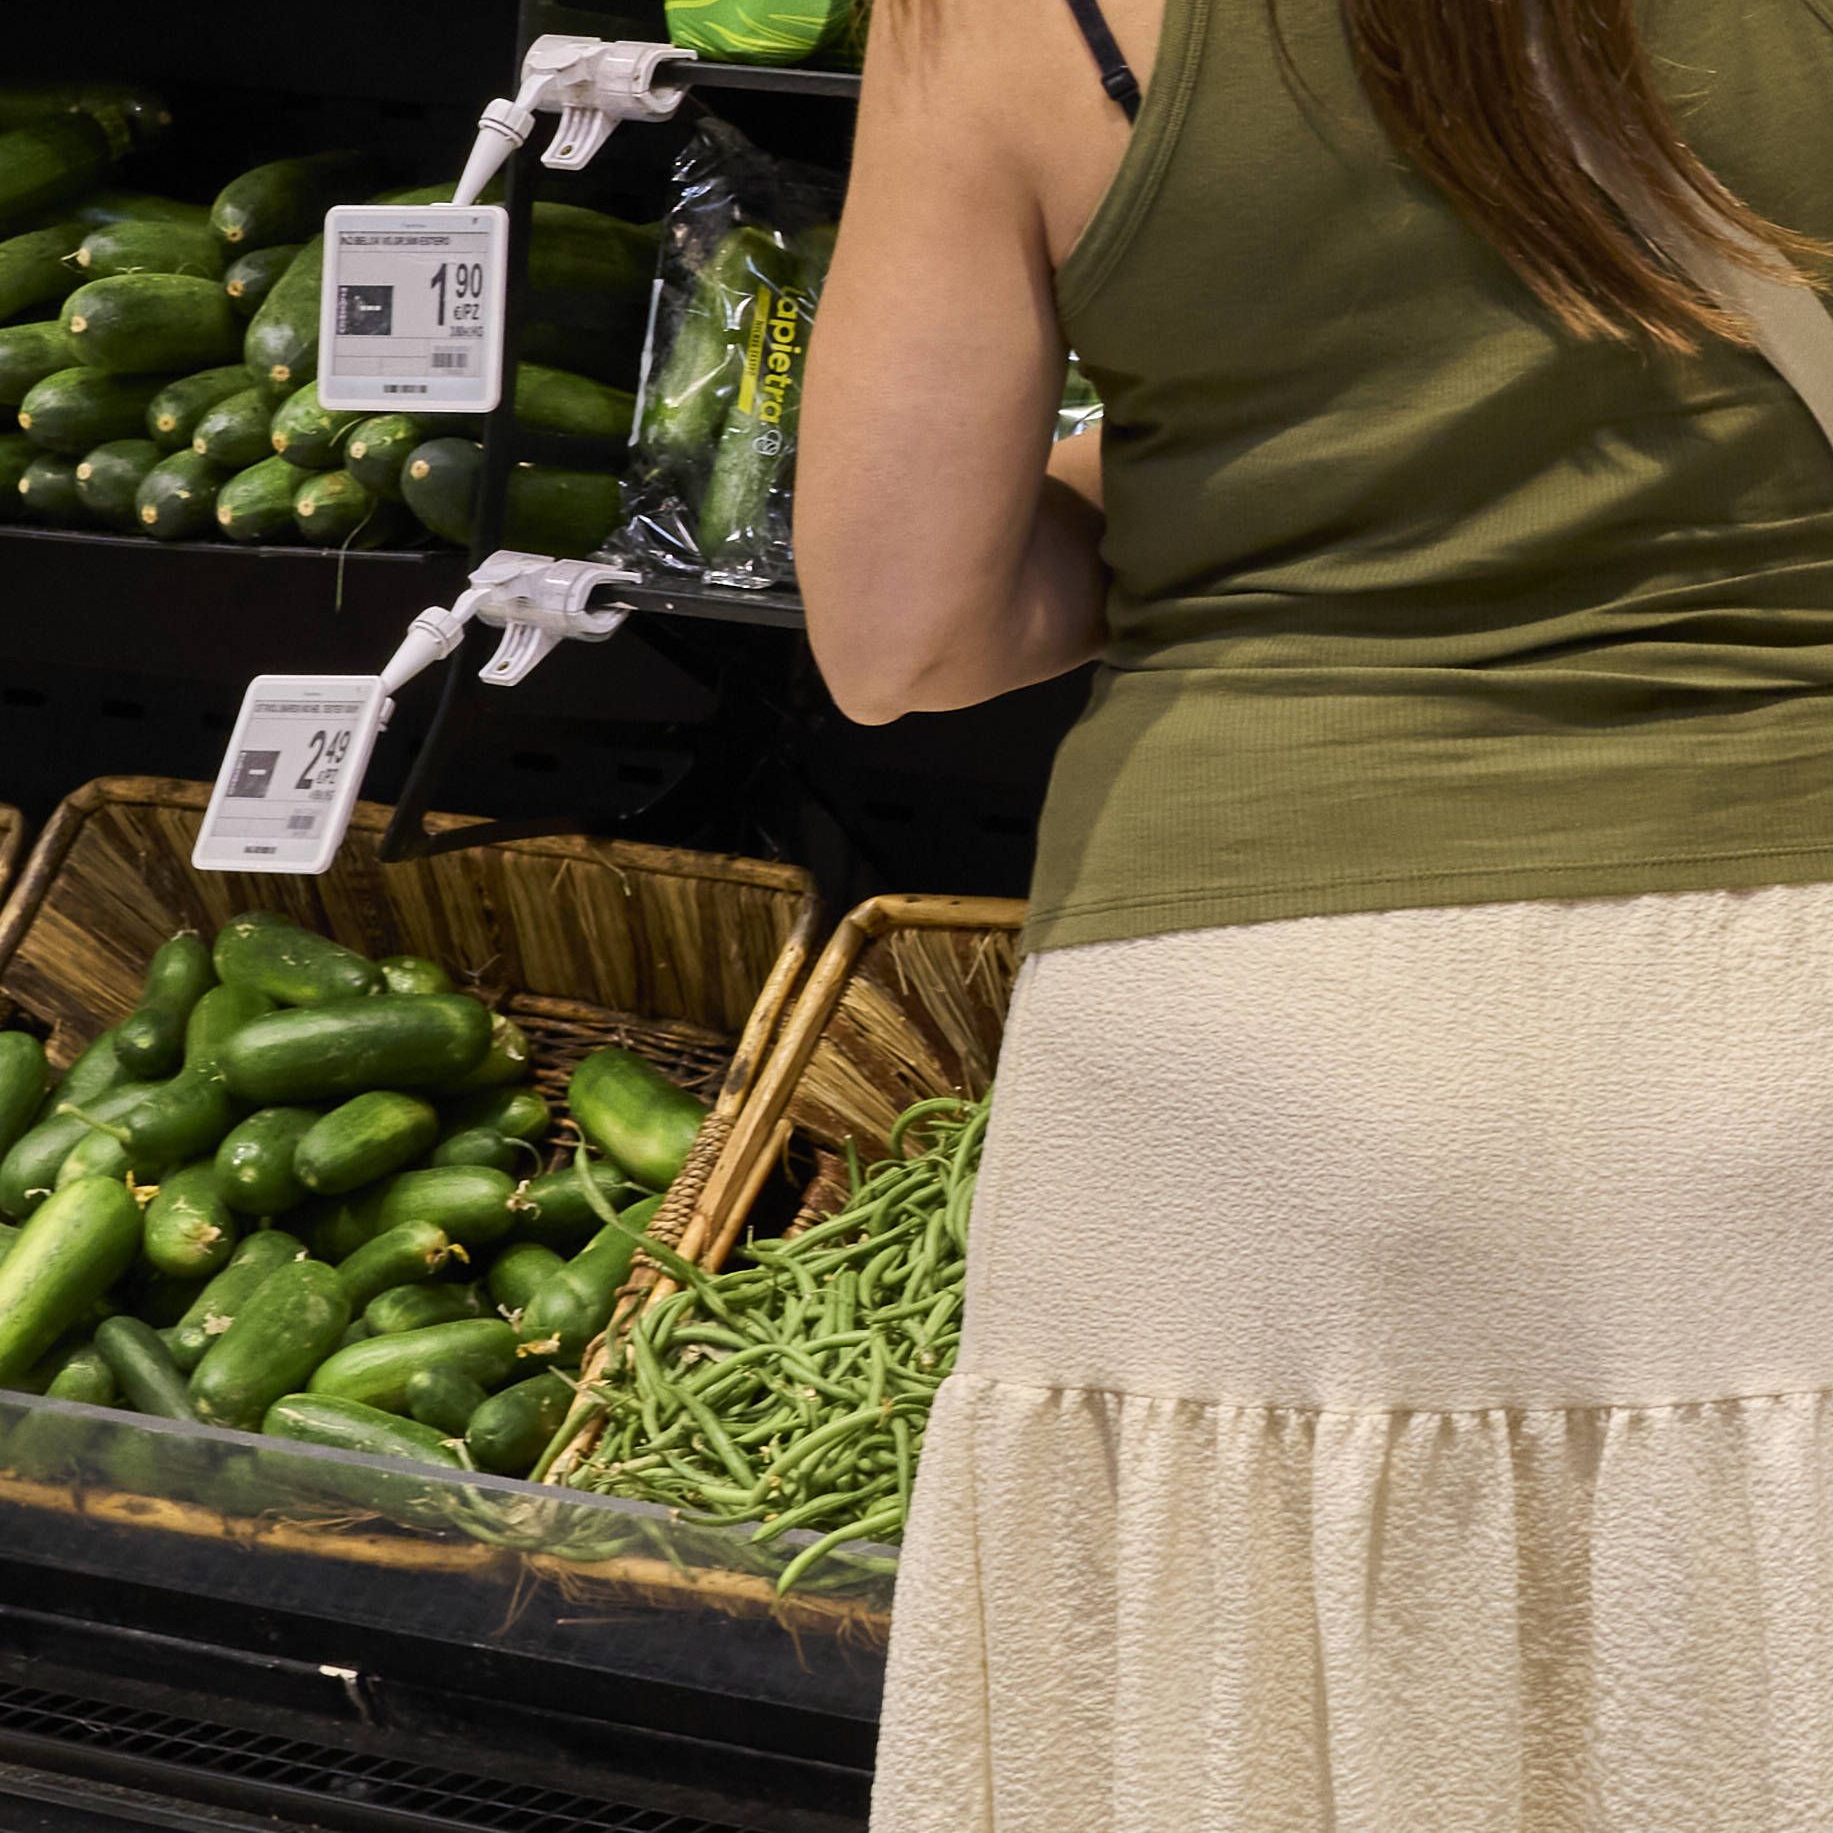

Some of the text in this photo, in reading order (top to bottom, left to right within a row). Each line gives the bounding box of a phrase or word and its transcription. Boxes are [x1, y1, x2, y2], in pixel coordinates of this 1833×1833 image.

[430, 262, 483, 326] 1 90
[294, 729, 327, 790] 2
[325, 729, 353, 765] 49
